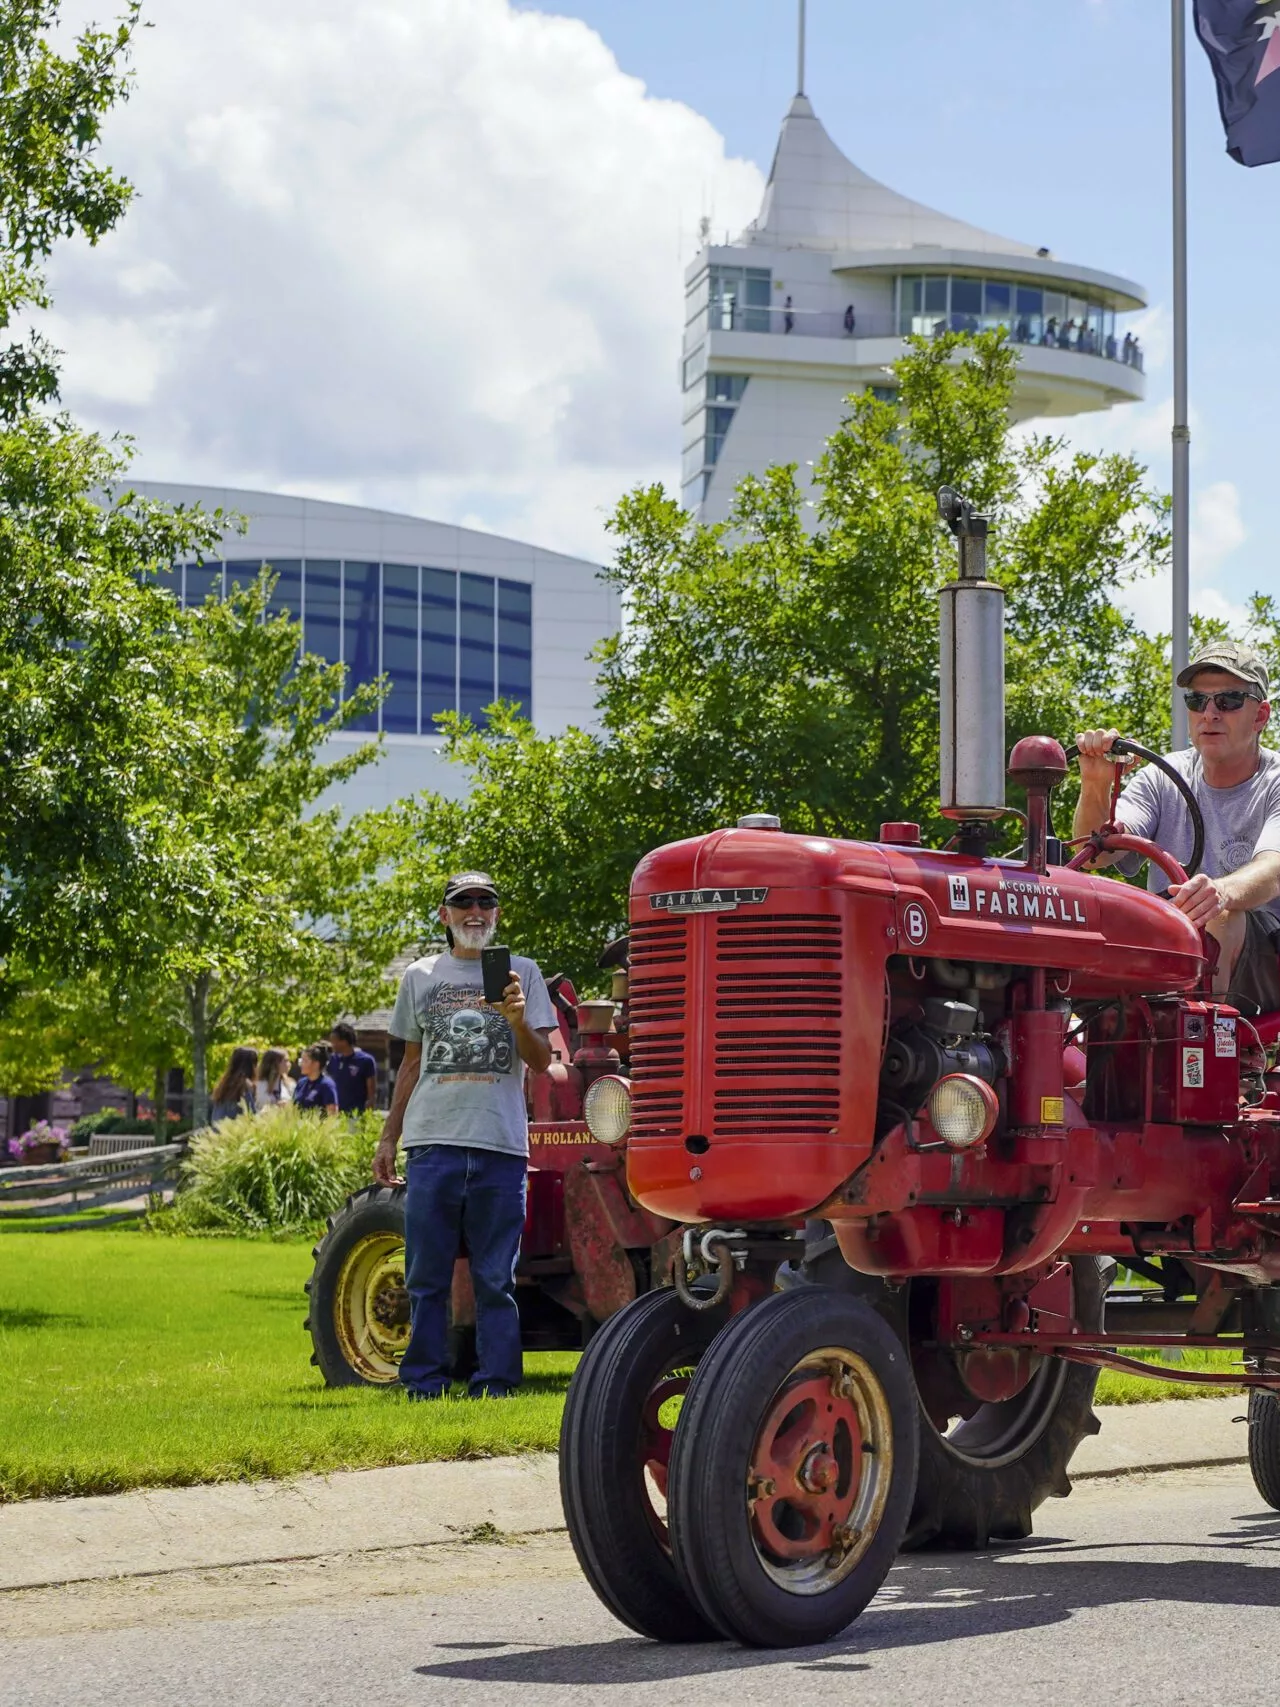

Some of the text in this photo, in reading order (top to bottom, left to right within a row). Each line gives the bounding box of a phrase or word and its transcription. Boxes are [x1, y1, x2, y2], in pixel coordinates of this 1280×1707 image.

[655, 890, 760, 908] FARMALL
[975, 889, 1086, 923] FARMALL
[909, 910, 924, 937] B
